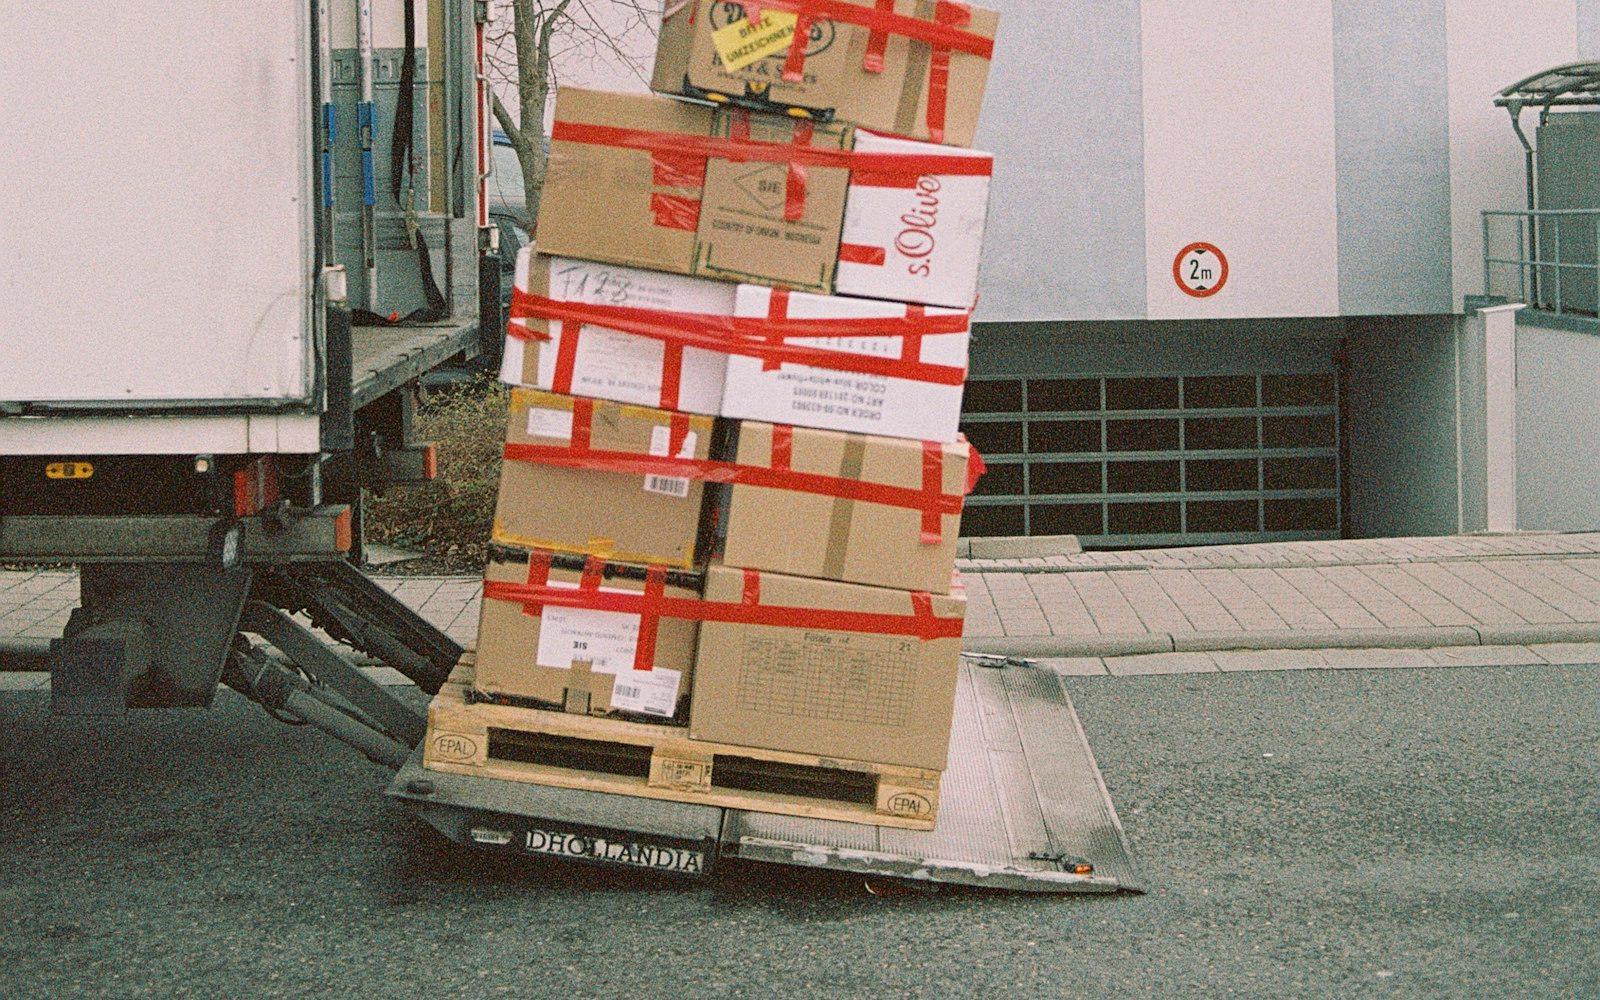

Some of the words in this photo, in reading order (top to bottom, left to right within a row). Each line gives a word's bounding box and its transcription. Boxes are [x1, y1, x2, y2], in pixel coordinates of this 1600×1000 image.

[725, 24, 794, 62] UMZEICHNEN
[895, 174, 941, 277] s.Olive
[572, 641, 588, 650] SIE
[439, 738, 469, 755] EPAL
[528, 829, 701, 873] DHOLLANDIA
